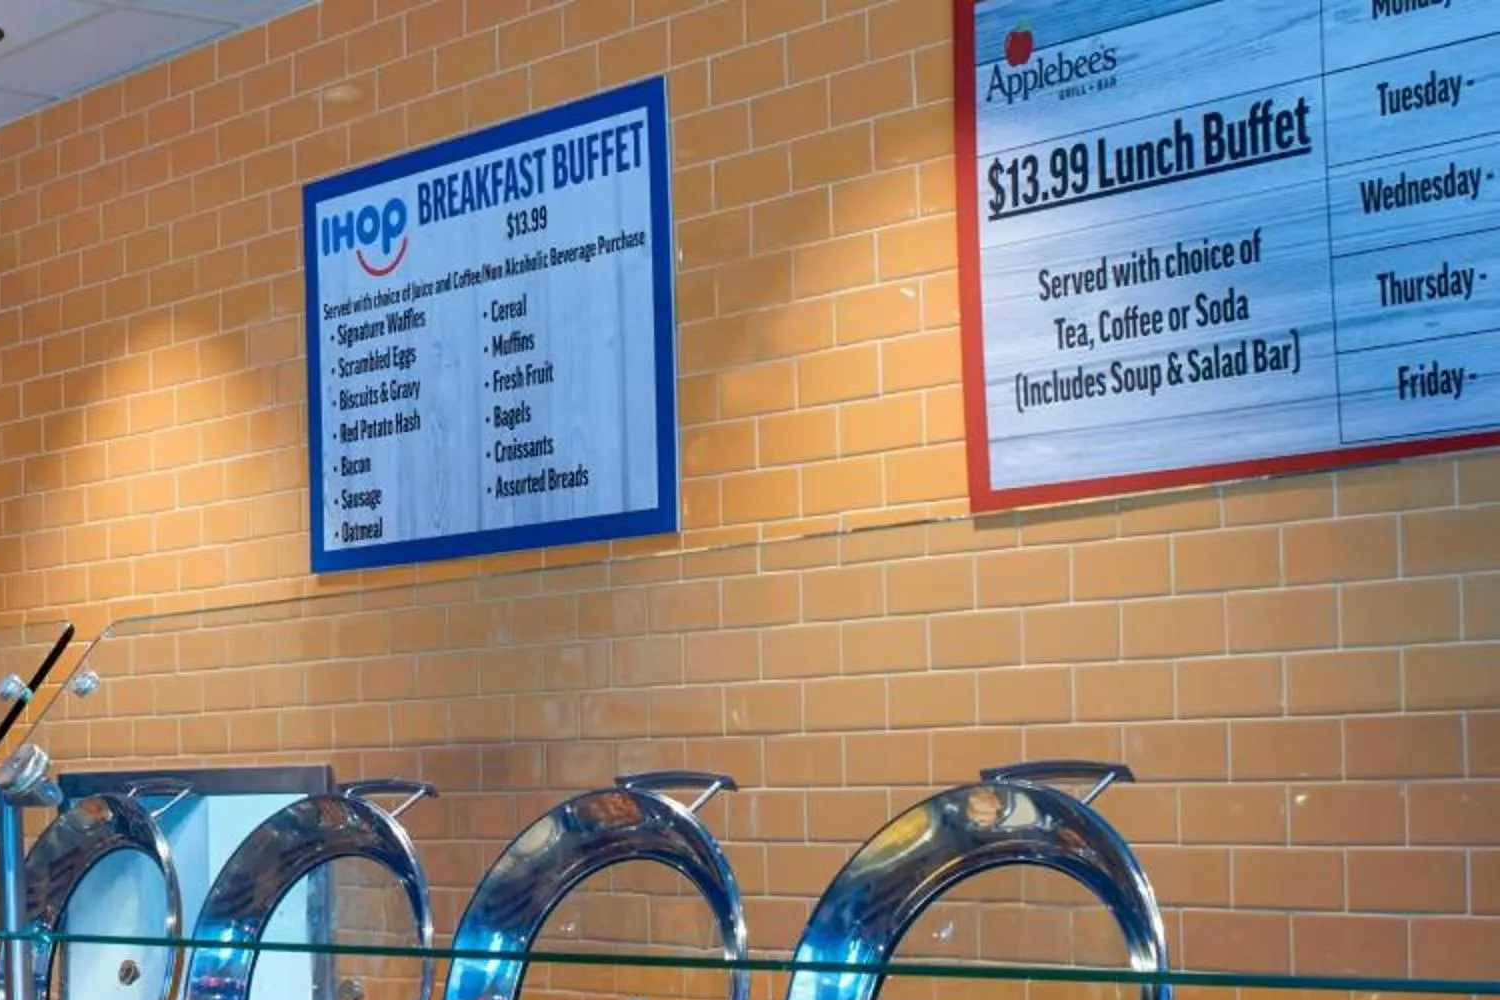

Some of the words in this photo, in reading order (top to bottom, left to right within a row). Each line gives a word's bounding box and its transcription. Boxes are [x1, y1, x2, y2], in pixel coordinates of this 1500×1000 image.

[985, 45, 1117, 105] Applebee's
[1376, 70, 1462, 116] Tuesday
[417, 148, 547, 226] BREAKFAST
[552, 120, 644, 189] BUFFET
[988, 143, 1089, 214] $13.99
[1098, 118, 1194, 188] Lunch
[1203, 96, 1311, 165] Buffet
[1360, 162, 1481, 214] Wednesday
[321, 198, 407, 256] IHOP
[506, 205, 547, 240] $13.99
[323, 296, 351, 320] Served
[505, 250, 548, 276] Alcoholic
[550, 243, 597, 267] Beverage
[598, 230, 645, 255] Purchase
[1038, 255, 1108, 302] Served
[1112, 247, 1161, 287] with
[1165, 238, 1235, 279] choice
[1239, 227, 1262, 265] of
[1376, 261, 1474, 307] Thursday
[491, 293, 527, 322] Cereal
[1054, 317, 1095, 350] Tea,
[1099, 305, 1164, 343] Coffee
[1168, 304, 1191, 332] or
[1195, 287, 1249, 328] Soda
[337, 319, 385, 348] Signature
[386, 307, 426, 334] Waffles
[491, 330, 535, 358] Muffins
[338, 345, 391, 379] Scrambled
[392, 345, 417, 371] Eggs
[493, 365, 524, 393] Fresh
[525, 360, 554, 387] Fruit
[1015, 365, 1107, 413] (Includes
[1110, 361, 1163, 396] Soup
[1167, 351, 1183, 386] &
[1187, 340, 1248, 383] Salad
[1252, 328, 1301, 375] Bar)
[1398, 360, 1465, 401] Friday
[339, 384, 379, 411] Biscuits
[380, 381, 389, 403] &
[389, 379, 421, 402] Gravy
[340, 419, 359, 444] Red
[360, 417, 394, 441] Potato
[395, 407, 421, 435] Hash
[493, 399, 532, 431] Bagels
[341, 455, 371, 477] Bacon
[494, 435, 555, 464] Croissants
[341, 489, 382, 511] Sausage
[495, 467, 546, 500] Assorted
[547, 463, 589, 491] Breads
[341, 516, 383, 543] Oatmeal
